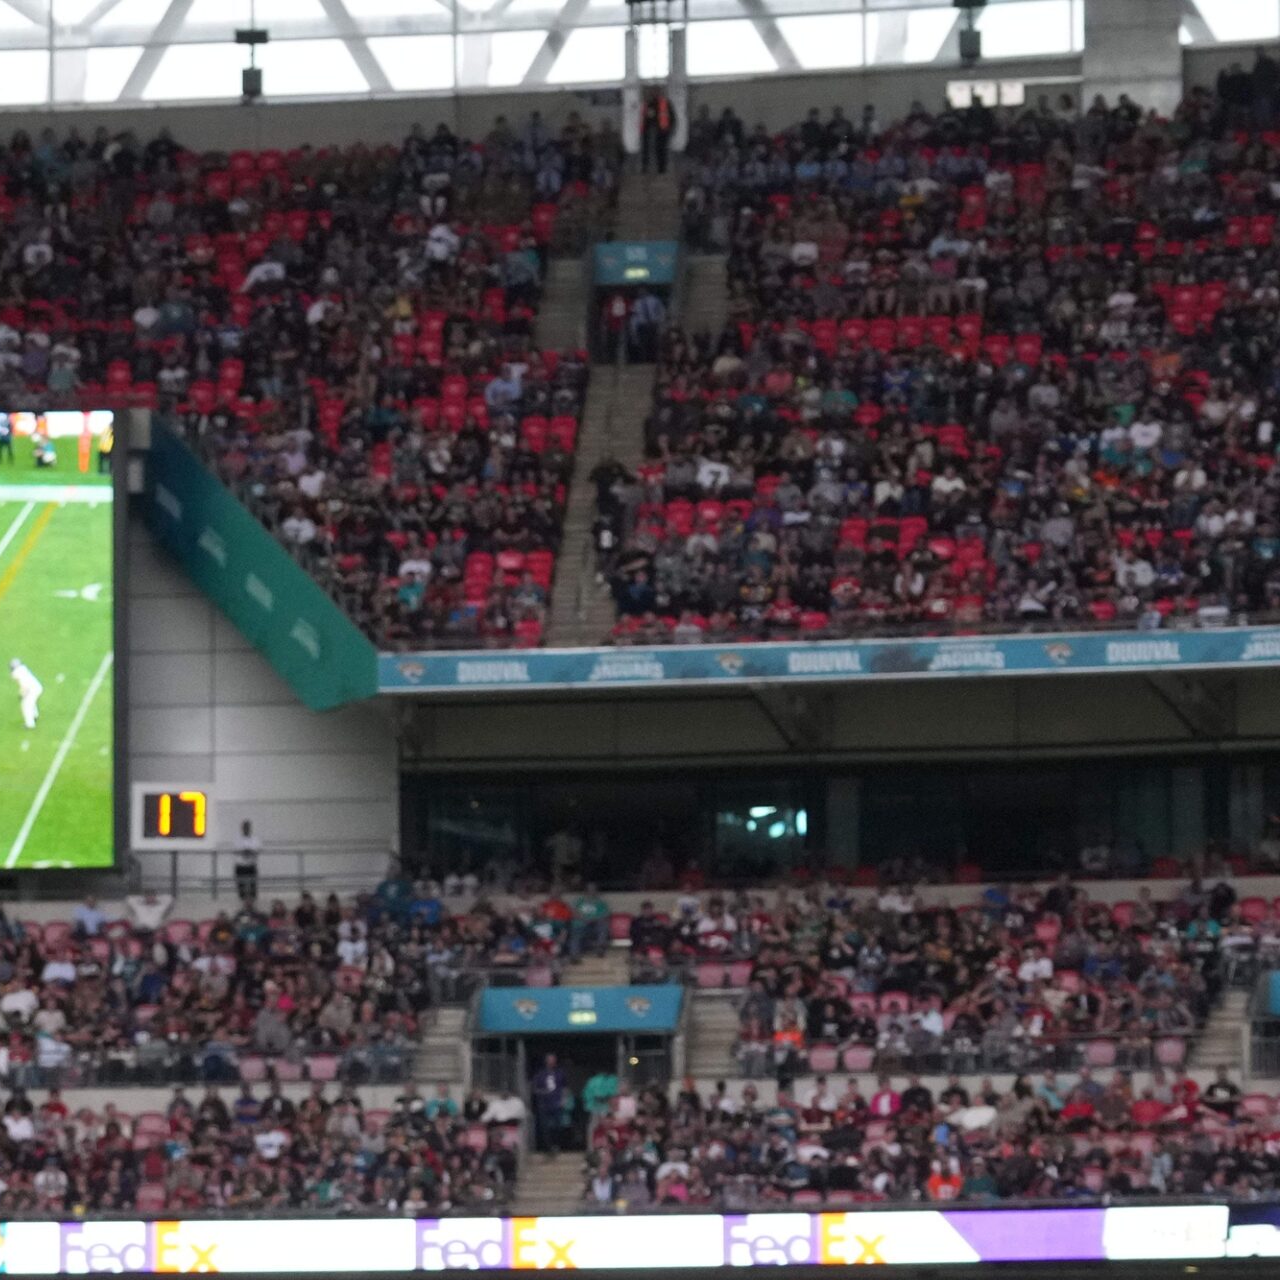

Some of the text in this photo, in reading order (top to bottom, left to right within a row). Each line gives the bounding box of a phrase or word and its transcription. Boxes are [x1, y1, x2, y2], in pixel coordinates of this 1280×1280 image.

[155, 791, 207, 838] 17
[59, 1220, 218, 1273] FedEx
[415, 1217, 579, 1270] FedEx
[723, 1212, 887, 1266] FedEx
